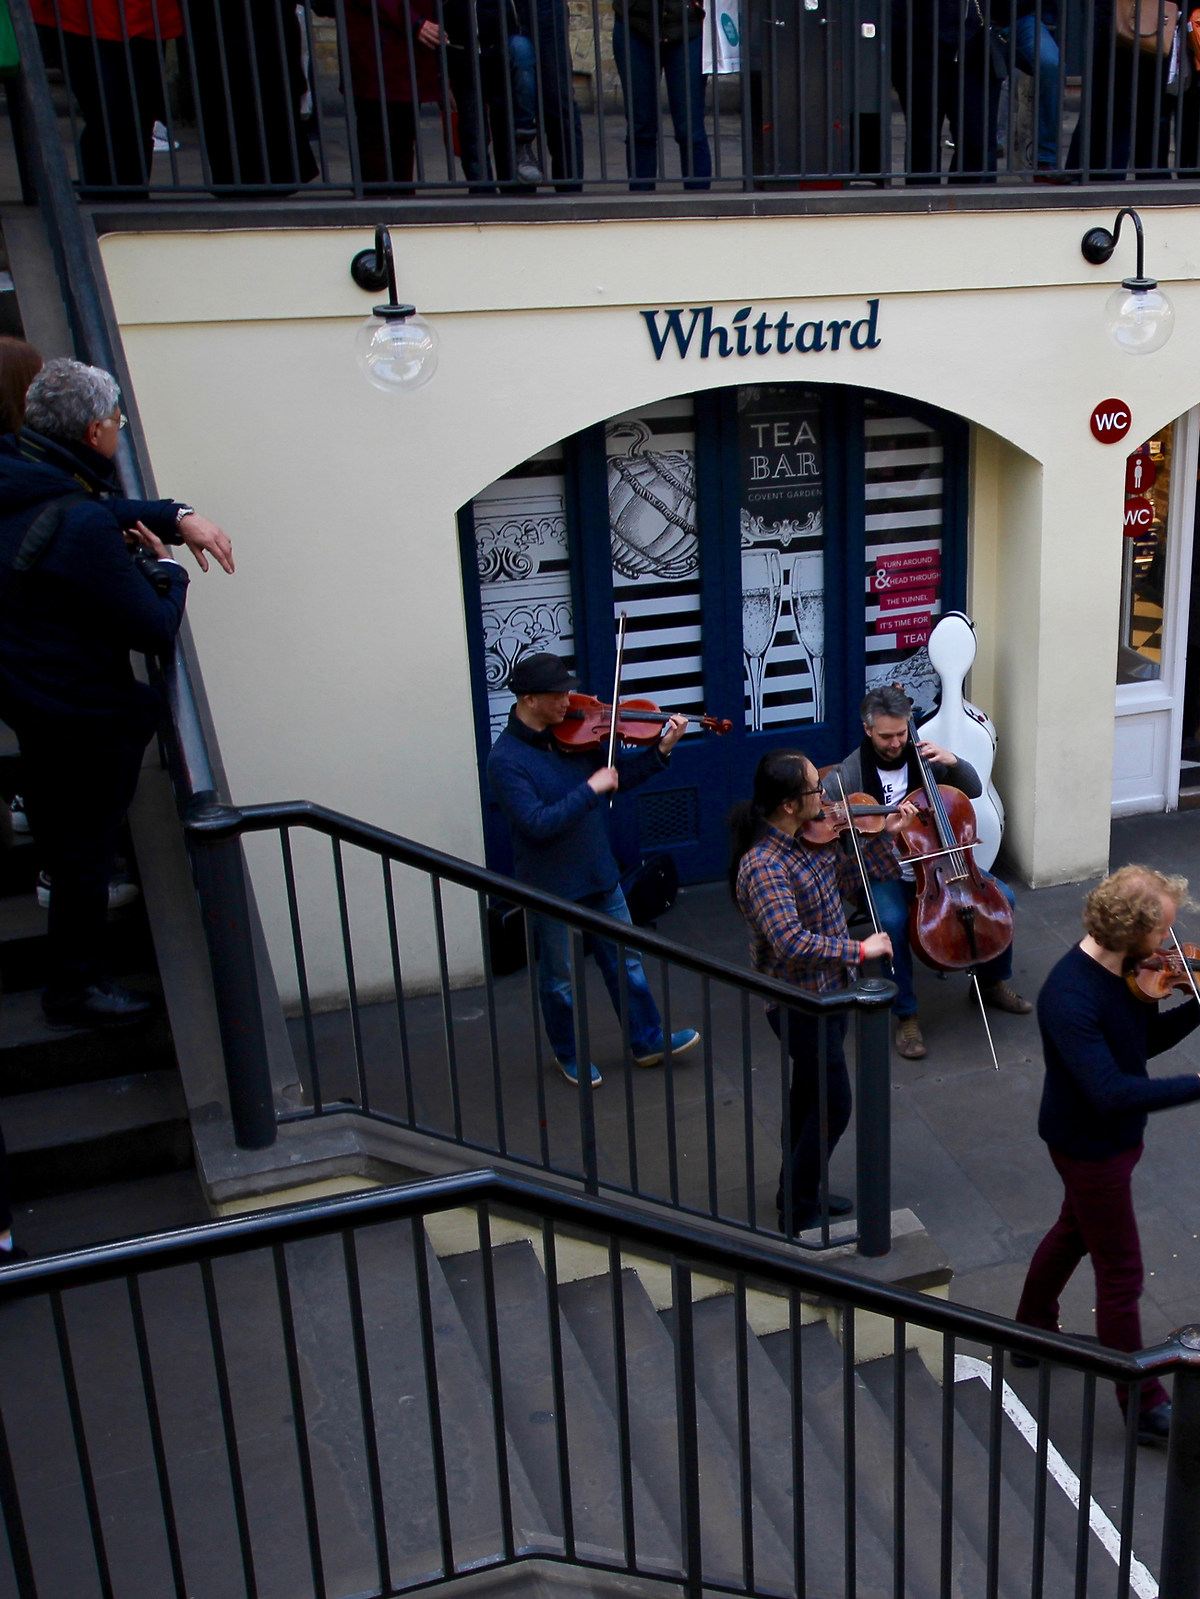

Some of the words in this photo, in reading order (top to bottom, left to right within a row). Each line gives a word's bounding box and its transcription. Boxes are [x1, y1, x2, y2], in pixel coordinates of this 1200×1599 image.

[639, 298, 882, 361] Whittard
[1095, 411, 1128, 431] WC
[750, 420, 817, 448] TEA
[750, 451, 820, 481] BAR
[748, 491, 783, 502] COVENT
[787, 488, 823, 499] GARDEN
[1123, 508, 1151, 526] WC
[883, 560, 901, 568] TURN
[903, 556, 933, 566] AROUND
[875, 568, 891, 589] &
[890, 577, 908, 586] HEAD
[887, 598, 900, 606] THE
[902, 594, 928, 604] TUNNEL
[880, 621, 893, 630] IT'S
[894, 618, 912, 628] TIME
[914, 616, 928, 625] FOR
[904, 632, 927, 644] TEA!
